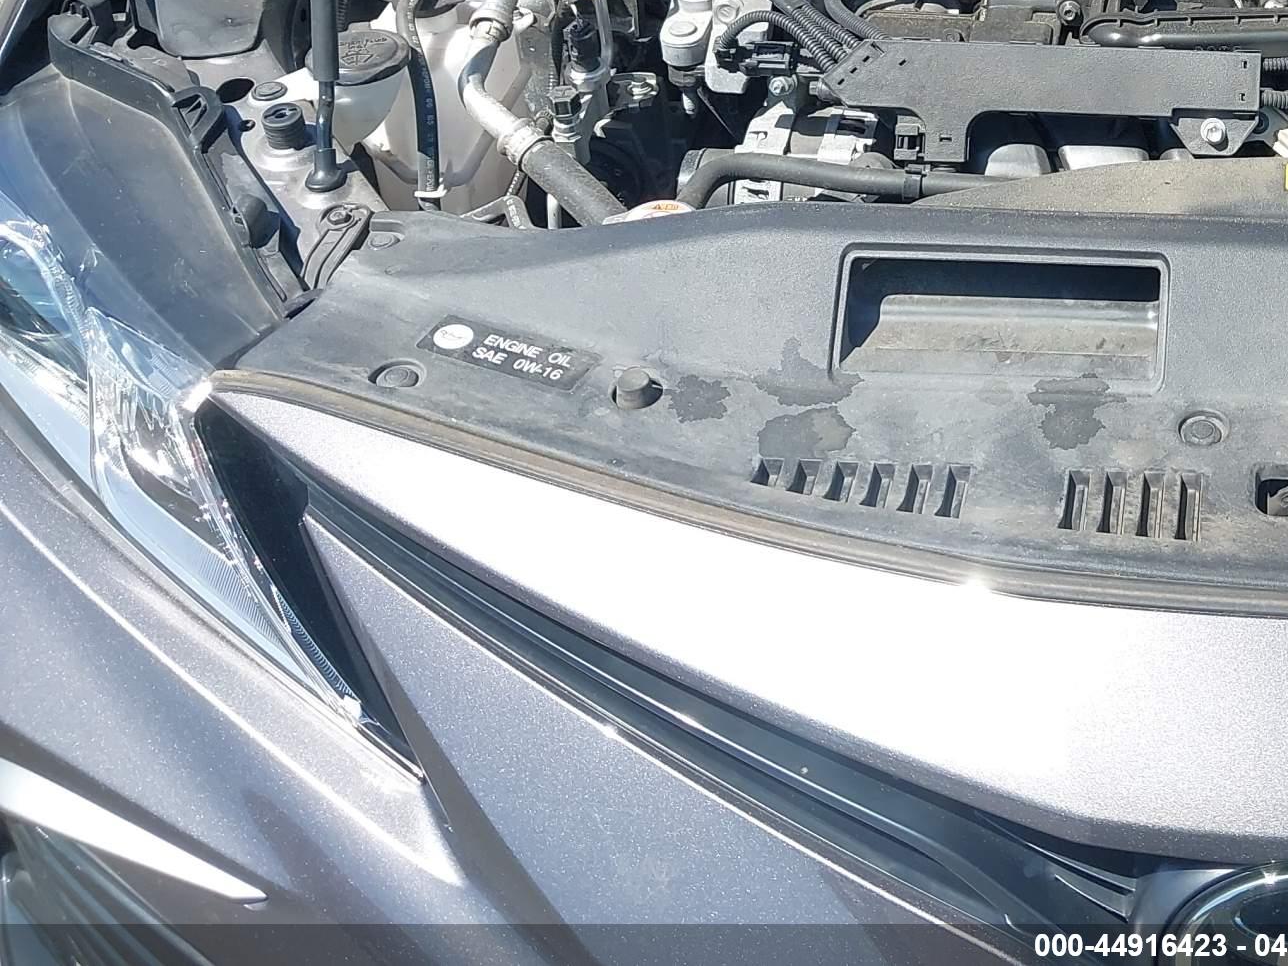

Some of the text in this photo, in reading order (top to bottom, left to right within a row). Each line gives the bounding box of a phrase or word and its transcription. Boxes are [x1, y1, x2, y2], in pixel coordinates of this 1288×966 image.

[472, 346, 564, 380] SAE 0W-16
[483, 334, 572, 368] ENGINE OIL
